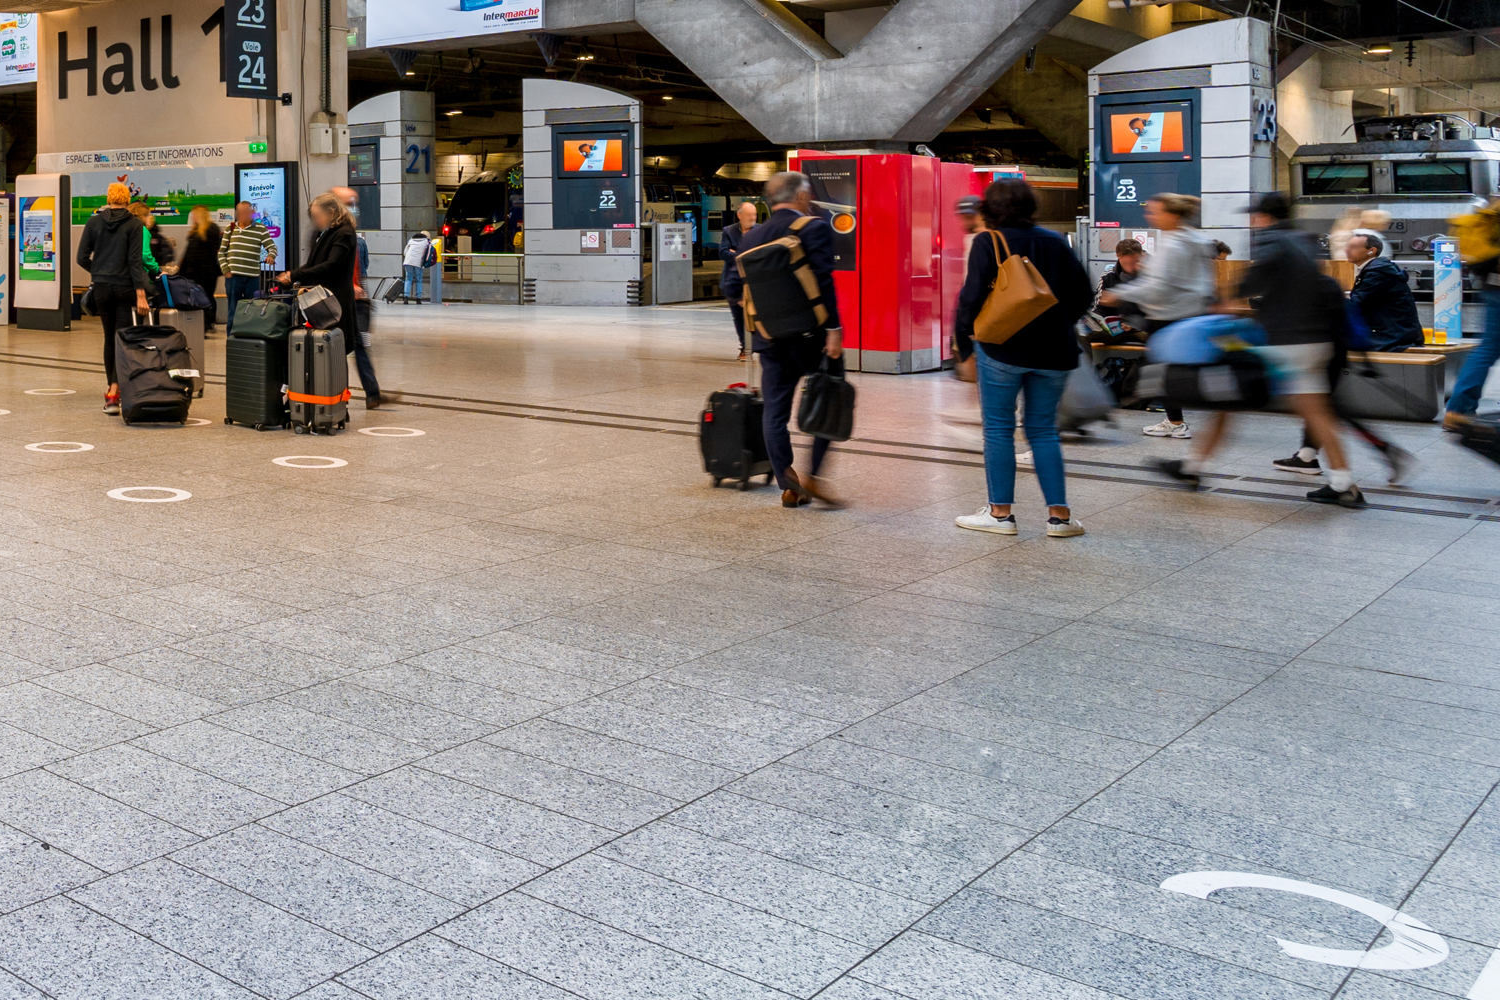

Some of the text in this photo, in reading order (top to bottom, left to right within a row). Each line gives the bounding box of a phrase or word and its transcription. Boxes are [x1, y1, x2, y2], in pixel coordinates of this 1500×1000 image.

[483, 8, 540, 22] Intermarché
[58, 6, 227, 100] Hall 1
[245, 43, 259, 51] Voie
[239, 55, 266, 85] 24
[1254, 98, 1278, 142] 23
[66, 147, 224, 164] ESPACE VENTES ET INFORMATIONS
[406, 145, 431, 174] 21
[249, 183, 275, 192] Bénévole
[1116, 186, 1137, 200] 23
[600, 195, 616, 207] 22
[655, 211, 668, 219] Région
